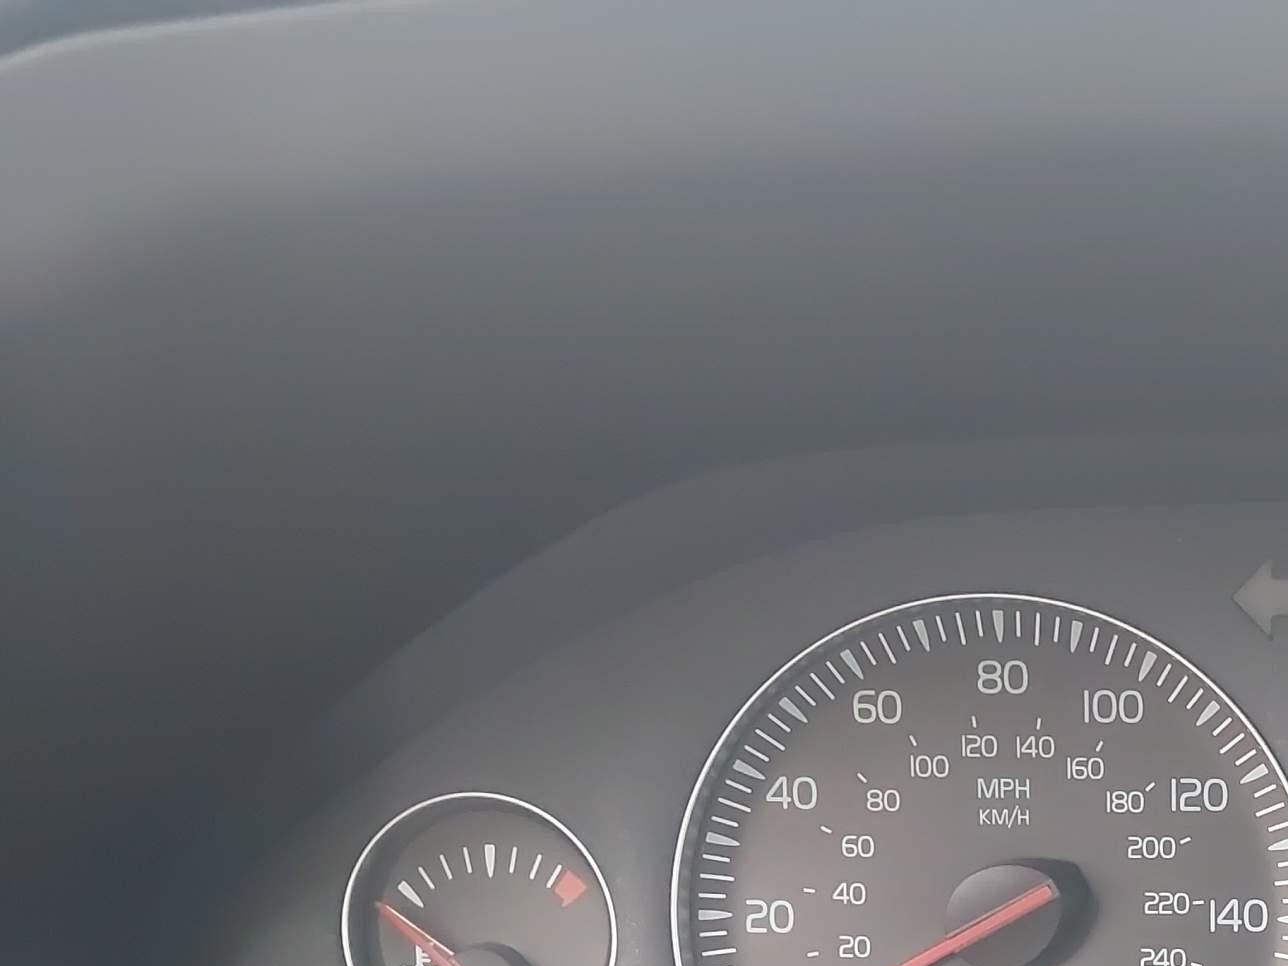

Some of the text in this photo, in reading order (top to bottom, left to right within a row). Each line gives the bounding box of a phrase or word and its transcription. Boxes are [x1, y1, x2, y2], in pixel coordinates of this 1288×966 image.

[976, 660, 1028, 695] 80
[852, 690, 902, 725] 60
[1083, 690, 1144, 725] 100
[961, 735, 997, 758] 120
[1016, 736, 1055, 759] 140
[909, 756, 950, 778] 100
[1066, 757, 1104, 780] 160
[766, 777, 818, 810] 40
[866, 789, 900, 812] 80
[977, 779, 1030, 799] MPH
[1170, 779, 1228, 812] 120
[1106, 790, 1145, 813] 180
[978, 806, 1030, 829] KM/H
[841, 836, 875, 858] 60
[1127, 837, 1176, 859] 200
[833, 882, 866, 905] 40
[1144, 892, 1190, 915] 220
[745, 900, 794, 933] 20
[1209, 899, 1268, 933] 140
[839, 935, 871, 958] 20
